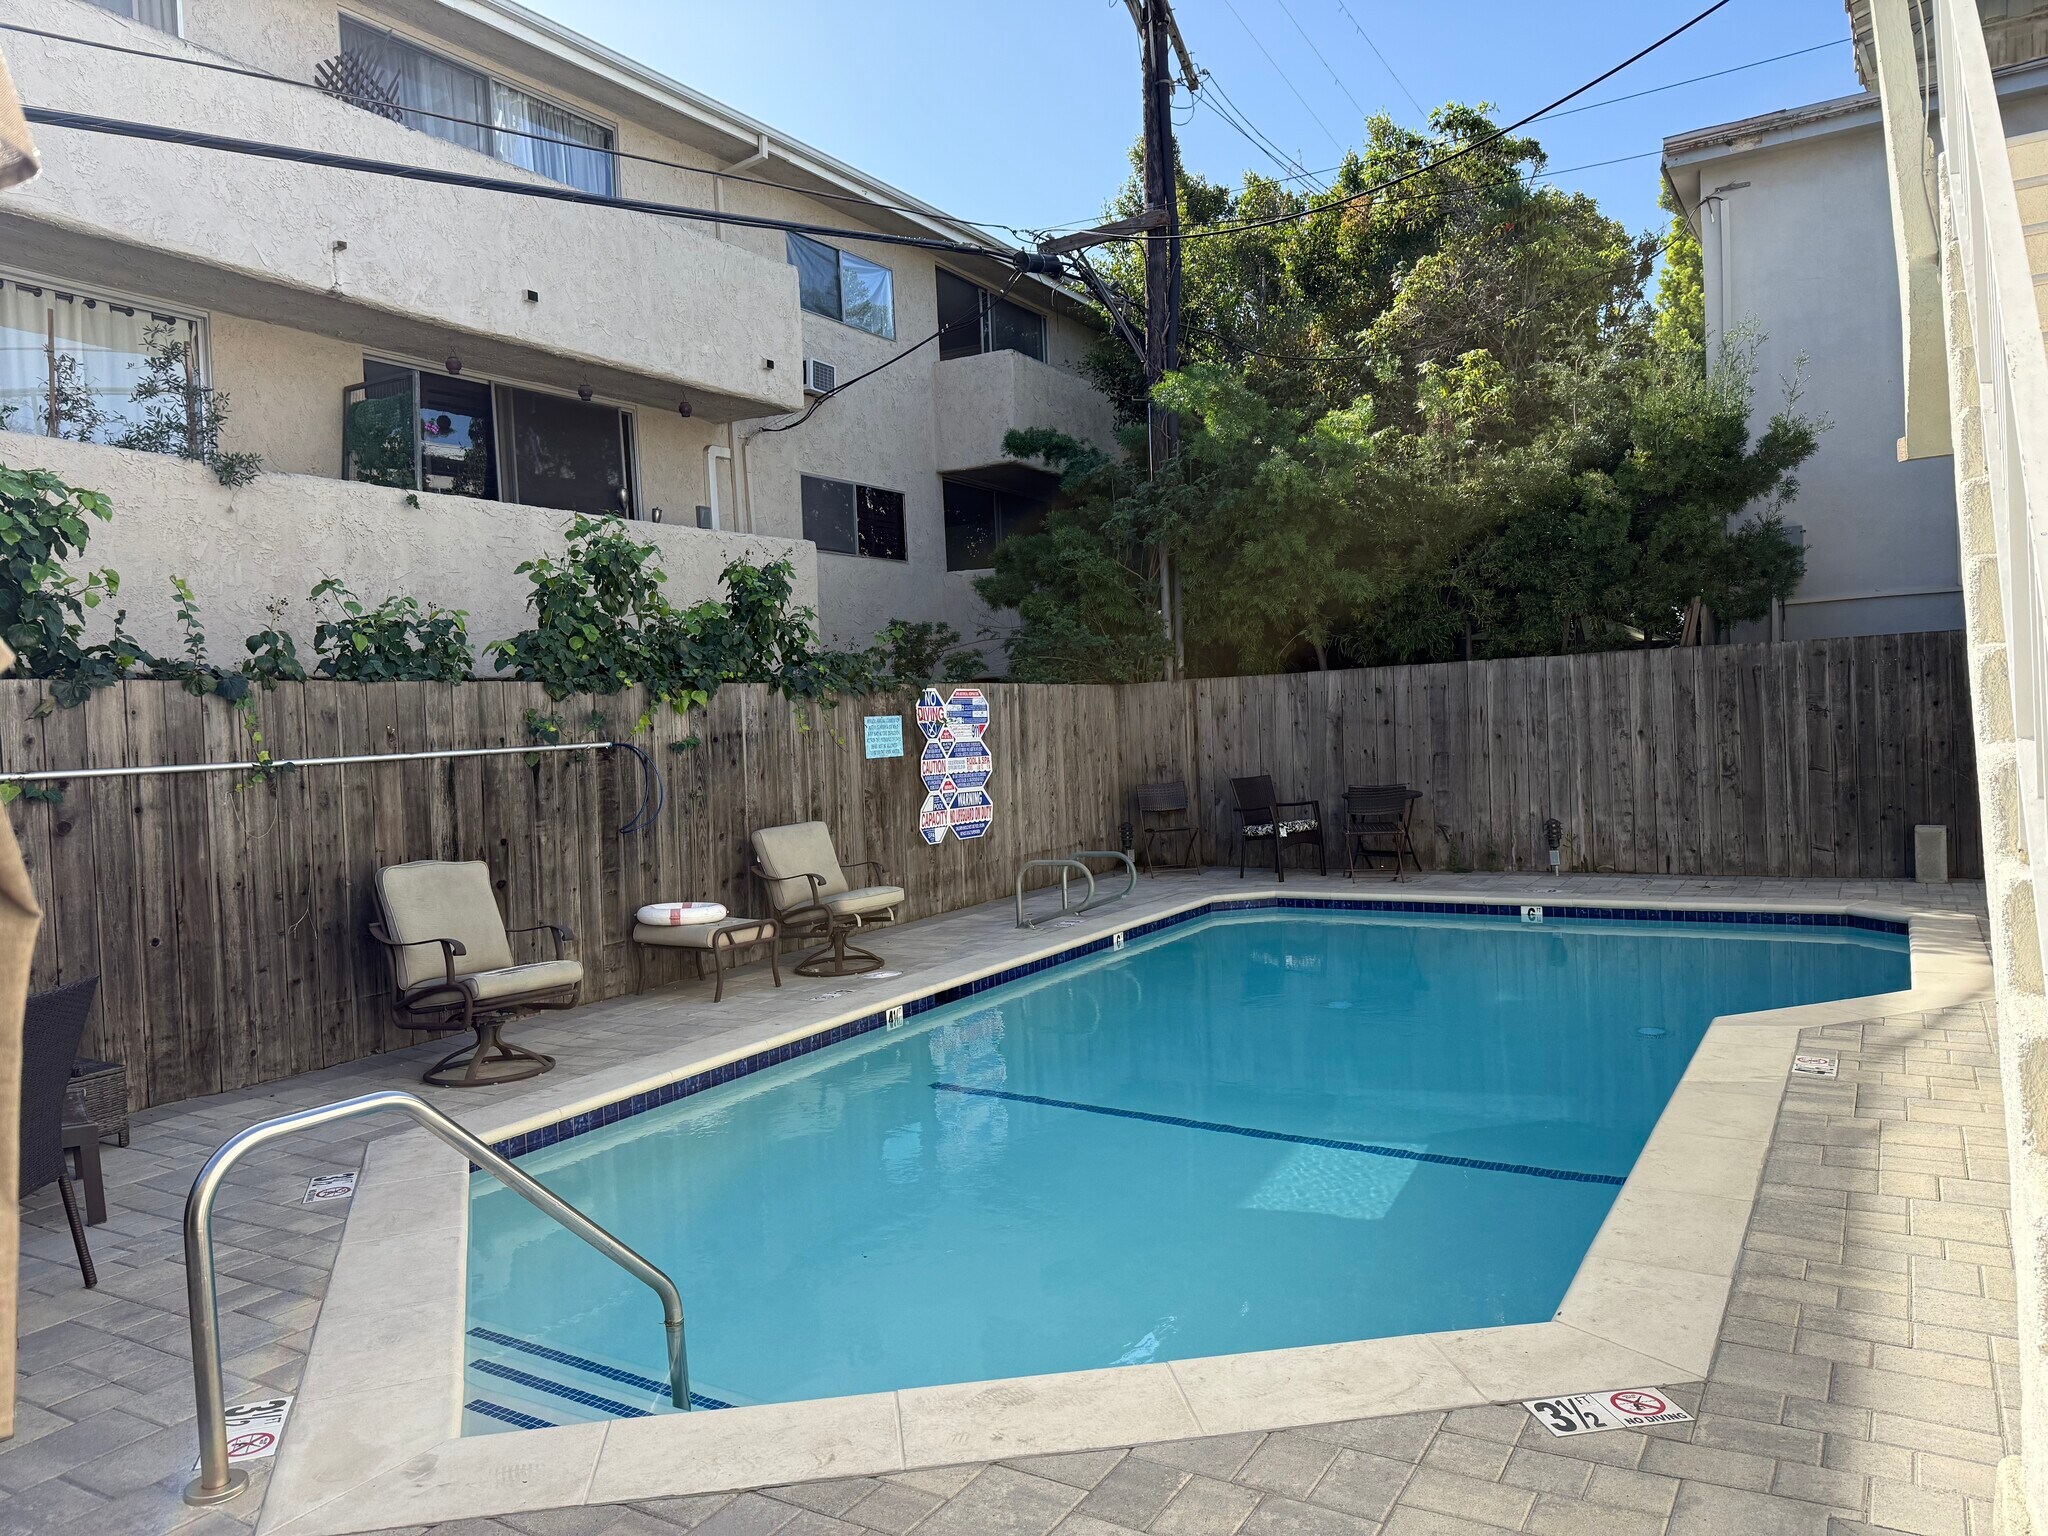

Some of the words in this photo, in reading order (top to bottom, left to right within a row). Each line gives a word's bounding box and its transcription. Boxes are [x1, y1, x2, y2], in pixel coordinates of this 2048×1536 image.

[924, 690, 937, 706] NO
[917, 707, 945, 722] DIVING
[922, 760, 947, 774] CAUTION
[957, 791, 983, 807] WARNING
[921, 810, 947, 828] CAPACITY
[956, 808, 974, 823] LIFEGUARD
[981, 805, 992, 820] DUTY
[1574, 1395, 1590, 1406] FT
[1624, 1415, 1643, 1425] NO
[1647, 1411, 1688, 1424] DIVING
